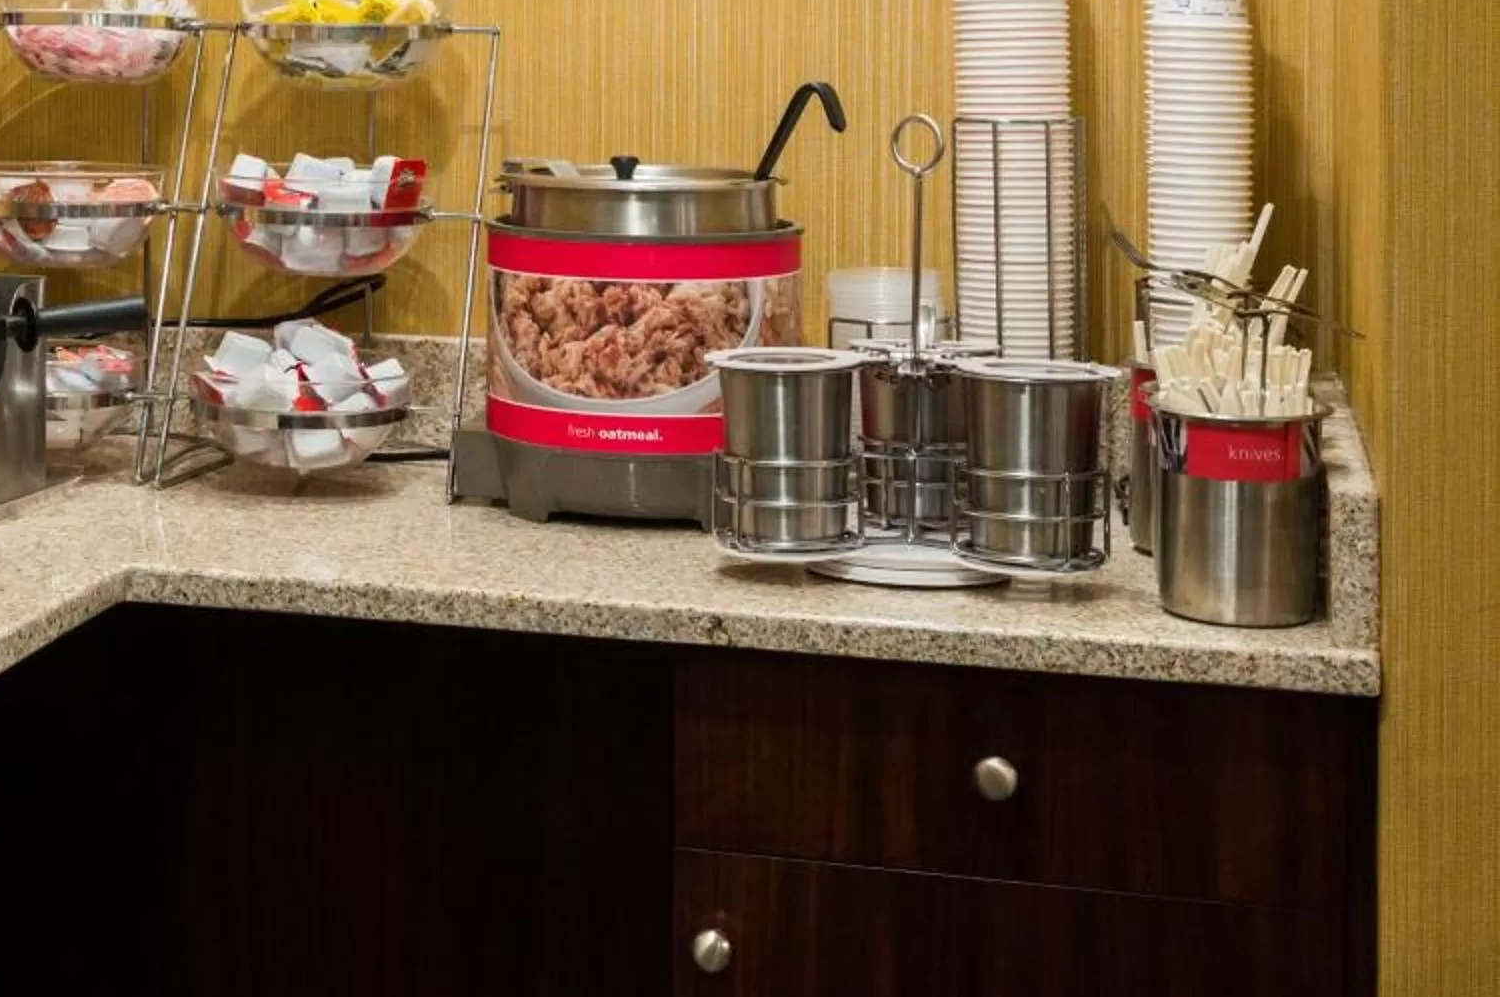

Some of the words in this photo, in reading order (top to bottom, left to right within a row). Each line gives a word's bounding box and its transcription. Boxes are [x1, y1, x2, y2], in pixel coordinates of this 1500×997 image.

[567, 423, 595, 439] fresh
[598, 428, 664, 442] oatmeal.
[1227, 443, 1285, 461] knives.
